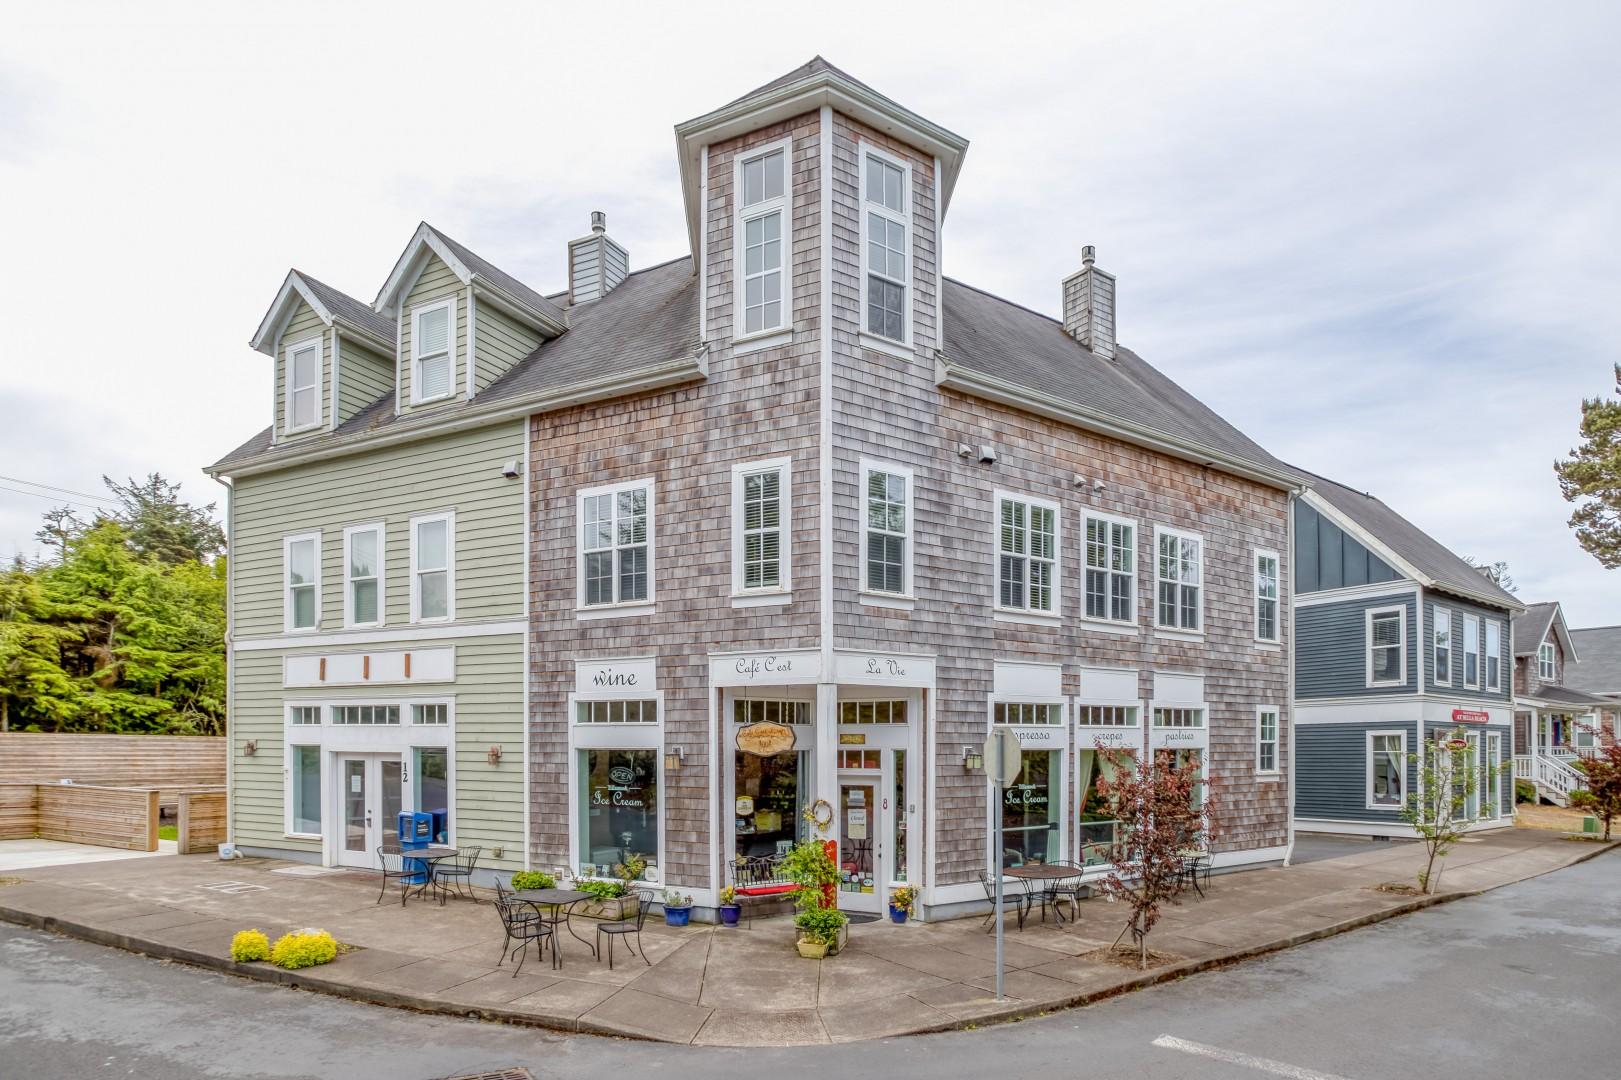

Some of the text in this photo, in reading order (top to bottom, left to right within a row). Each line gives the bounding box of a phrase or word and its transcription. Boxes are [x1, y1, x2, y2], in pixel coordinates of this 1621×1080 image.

[735, 656, 906, 679] Café C'est La Vie
[592, 668, 638, 686] wine
[1164, 728, 1195, 744] pastries
[403, 762, 408, 782] 12
[611, 770, 634, 781] OPEN
[593, 790, 643, 807] Ice Cream
[882, 798, 888, 810] 8
[1005, 789, 1048, 804] Ice Cream
